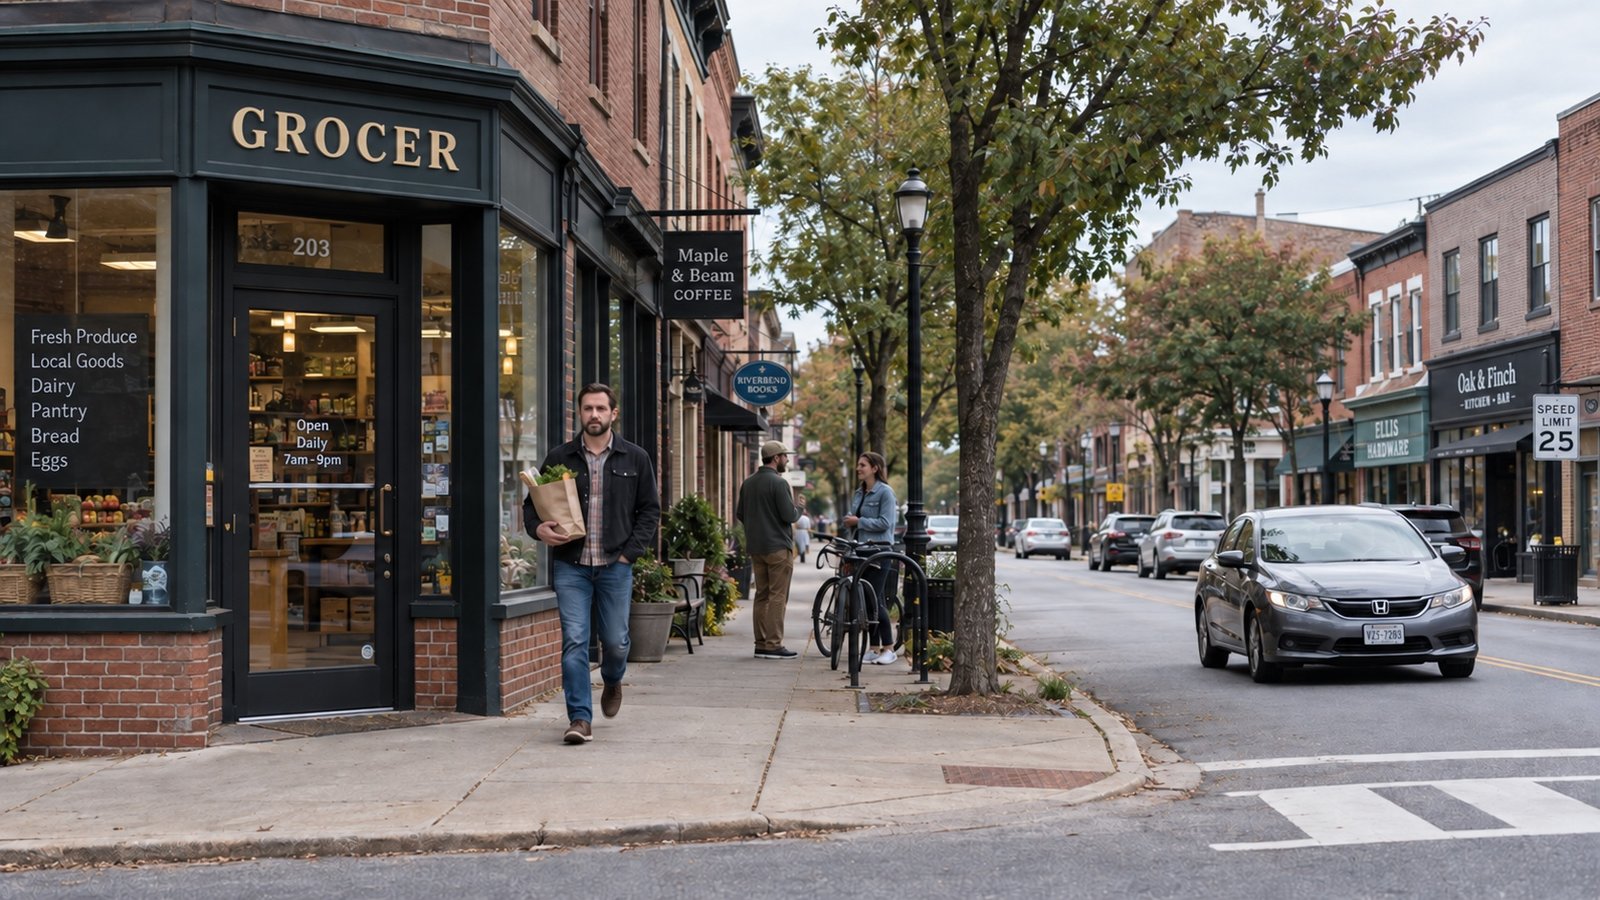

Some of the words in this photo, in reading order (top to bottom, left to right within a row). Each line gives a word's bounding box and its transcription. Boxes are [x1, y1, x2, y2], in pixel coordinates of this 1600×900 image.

[232, 106, 460, 171] GROCER
[293, 237, 332, 258] 203
[678, 247, 729, 266] Maple
[671, 268, 685, 283] &
[689, 268, 735, 283] Beam
[673, 289, 732, 301] COFFEE
[31, 328, 72, 344] Fresh
[76, 328, 138, 344] Produce
[31, 353, 72, 369] Local
[76, 353, 125, 369] Goods
[737, 376, 787, 385] RIVERBEND
[1457, 371, 1477, 394] Oak
[1477, 368, 1486, 389] &
[1487, 362, 1517, 388] Finch
[31, 378, 76, 398] Dairy
[747, 385, 778, 394] BOOKS
[31, 403, 88, 423] Pantry
[1537, 404, 1576, 415] SPEED
[296, 418, 329, 434] Open
[1375, 418, 1399, 439] ELLIS
[1542, 417, 1572, 427] LIMIT
[31, 427, 81, 444] Bread
[296, 436, 328, 452] Daily
[1538, 430, 1574, 452] 25
[1367, 438, 1409, 459] HARDWARE
[31, 452, 69, 472] Eggs
